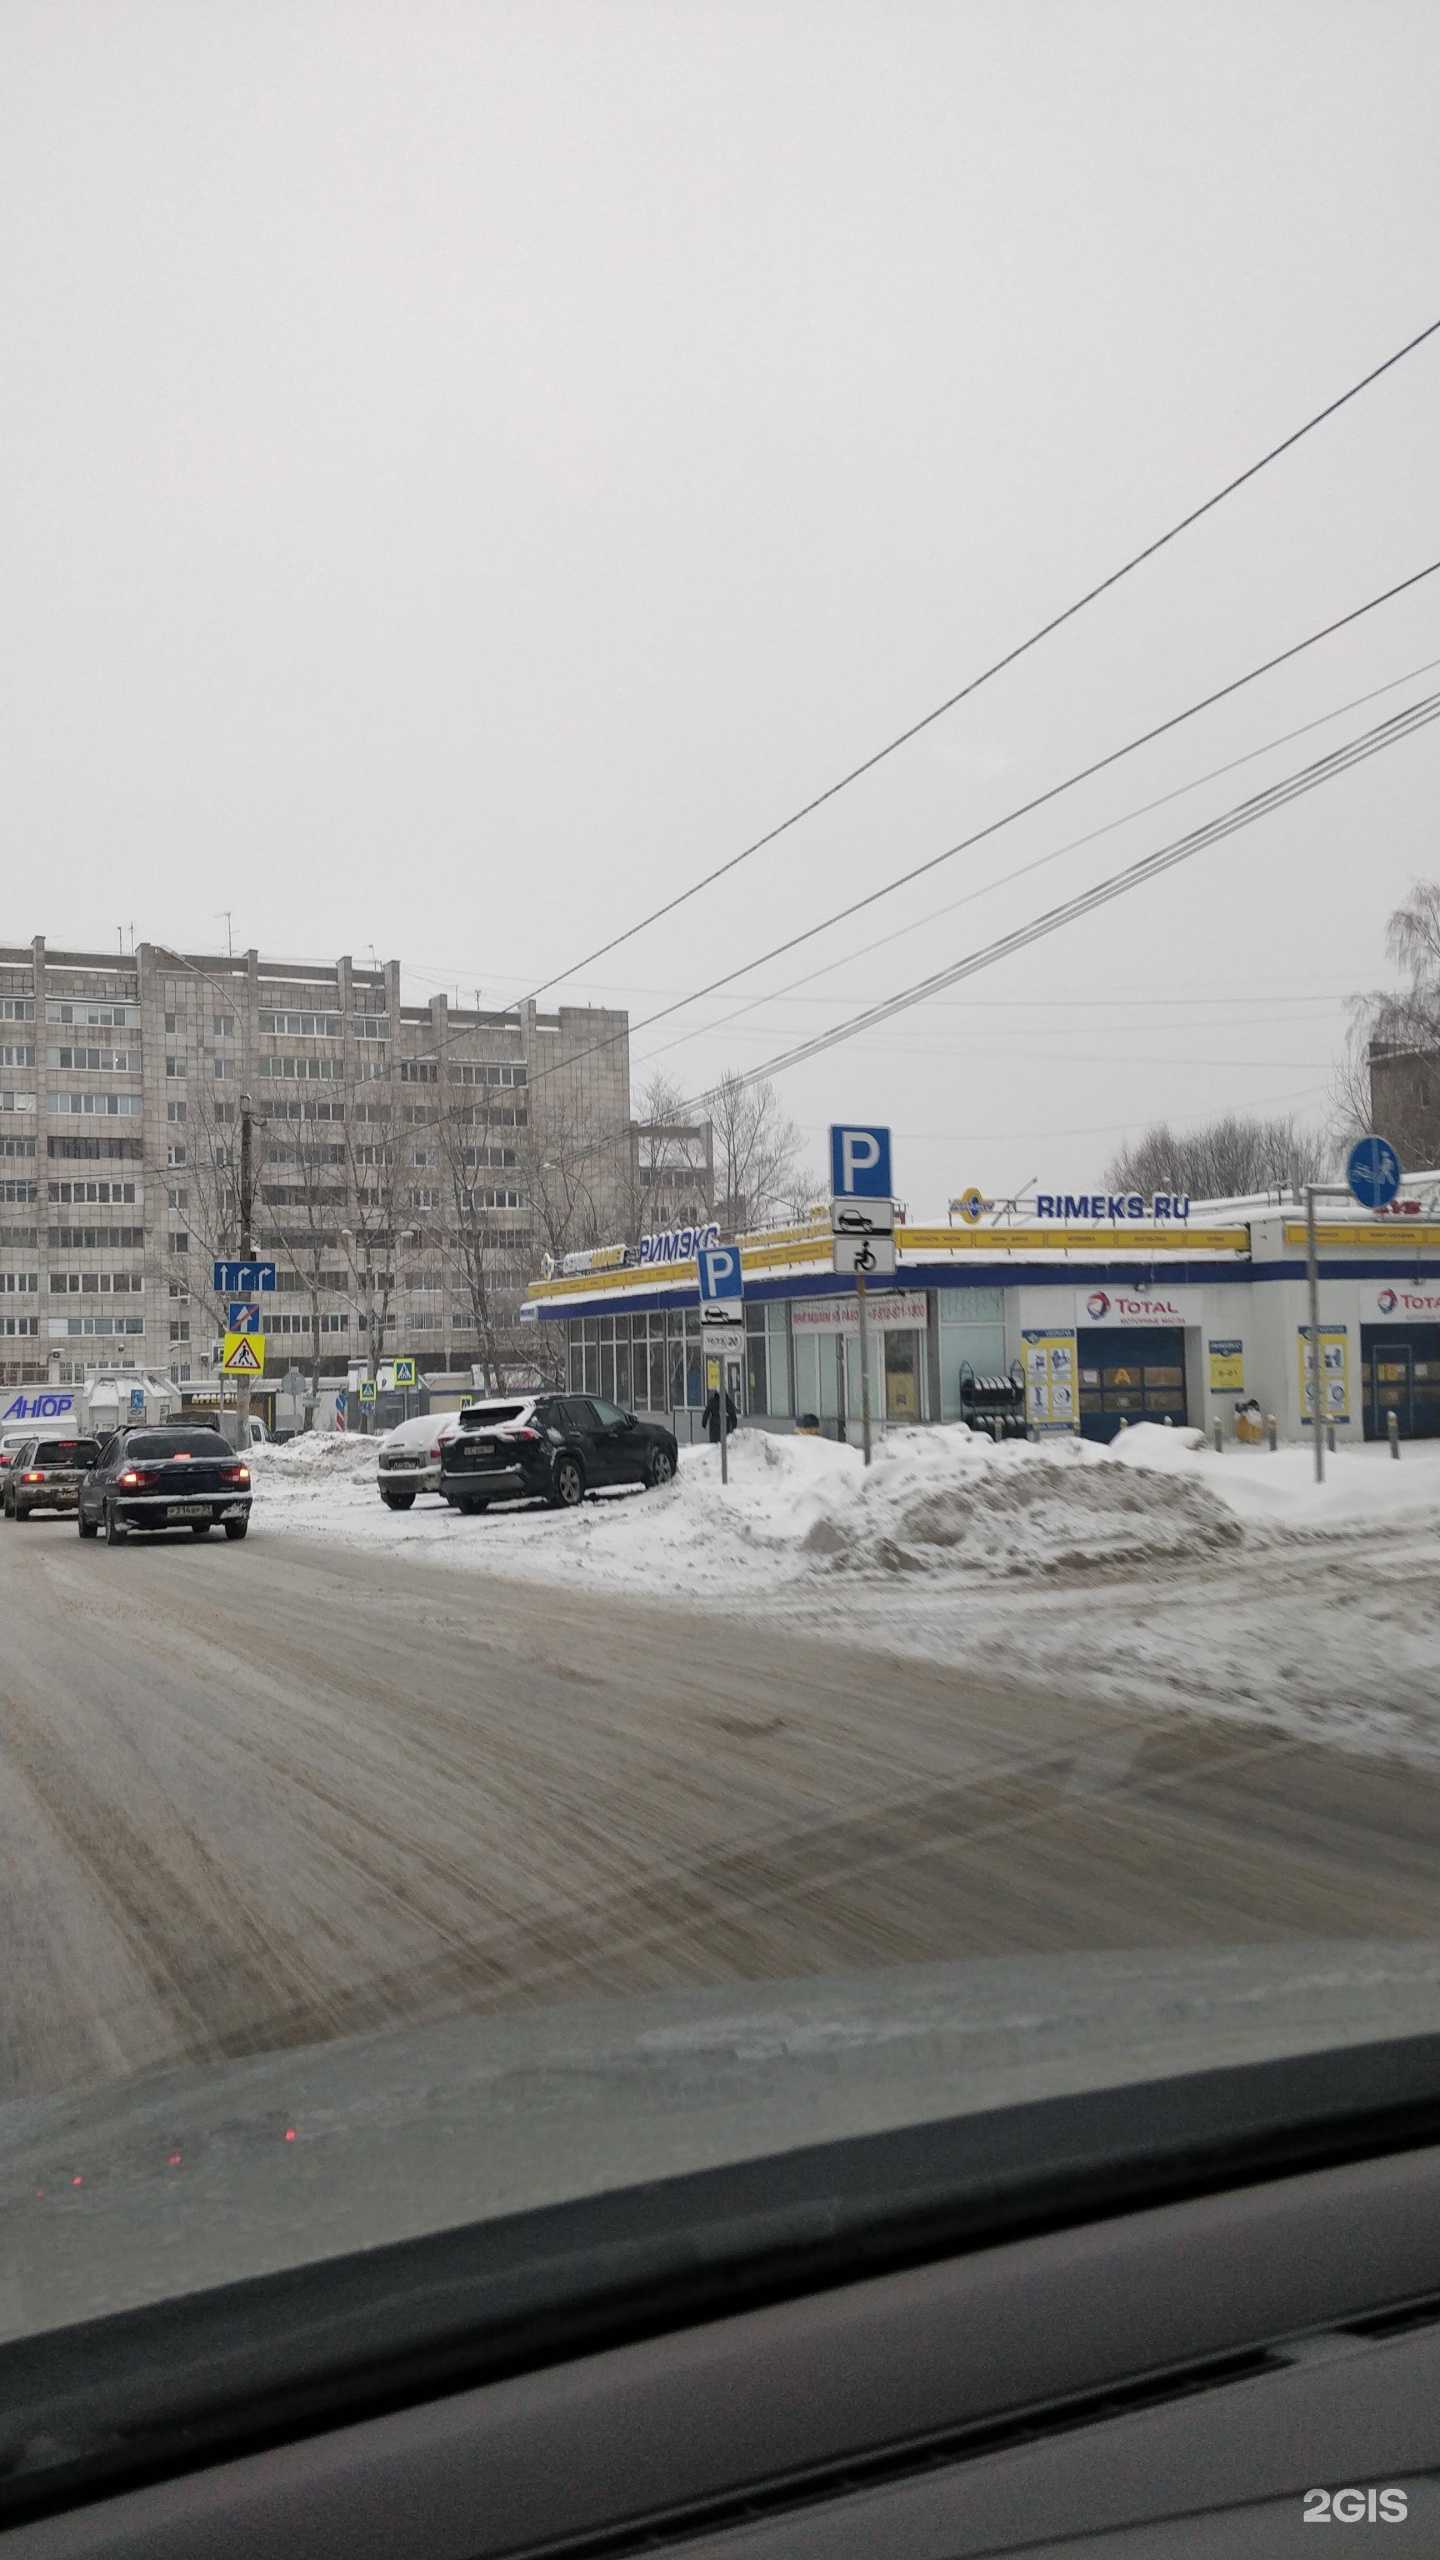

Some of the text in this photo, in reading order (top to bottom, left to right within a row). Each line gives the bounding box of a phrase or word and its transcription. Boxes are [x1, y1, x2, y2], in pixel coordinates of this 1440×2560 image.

[842, 1130, 881, 1193] P
[1037, 1195, 1190, 1219] RIMEKS.RU
[639, 1224, 720, 1264] РИМЭКС
[705, 1250, 735, 1298] P
[1114, 1298, 1179, 1314] TOTAL
[1400, 1294, 1440, 1309] TOTA
